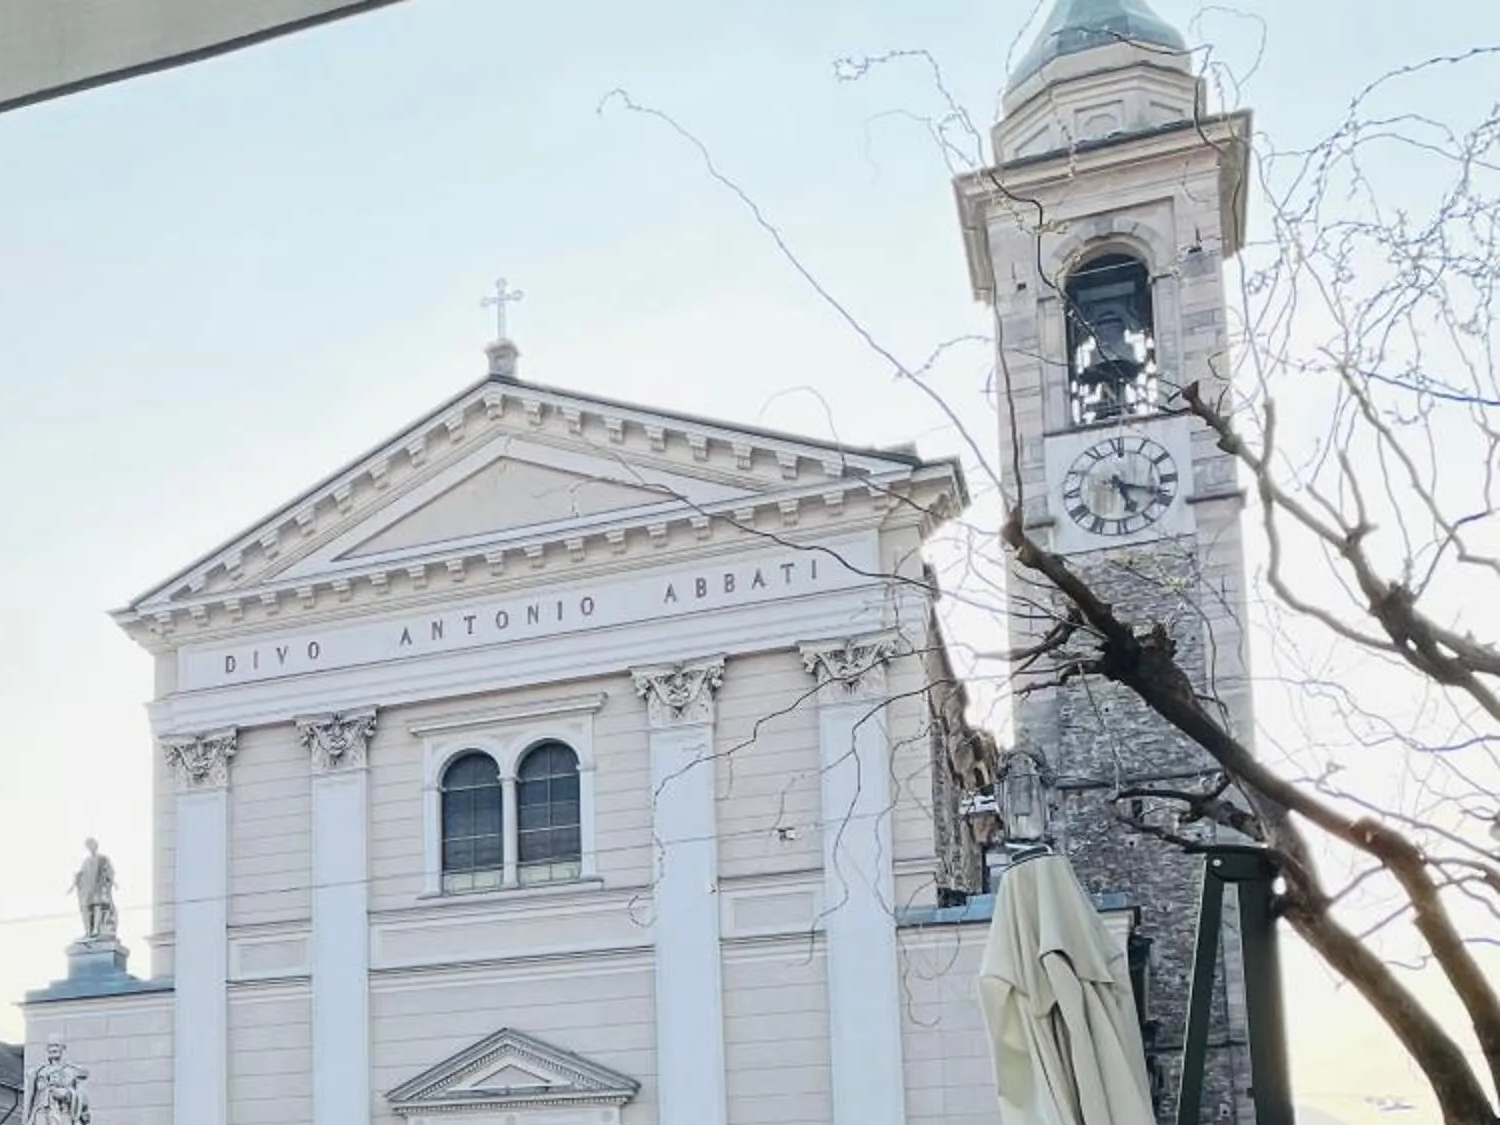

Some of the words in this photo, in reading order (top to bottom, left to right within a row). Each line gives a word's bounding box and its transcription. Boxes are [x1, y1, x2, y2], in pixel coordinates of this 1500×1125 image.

[224, 640, 321, 674] DIVO
[399, 596, 595, 647] ANTONIO
[653, 559, 818, 604] ABBATI
